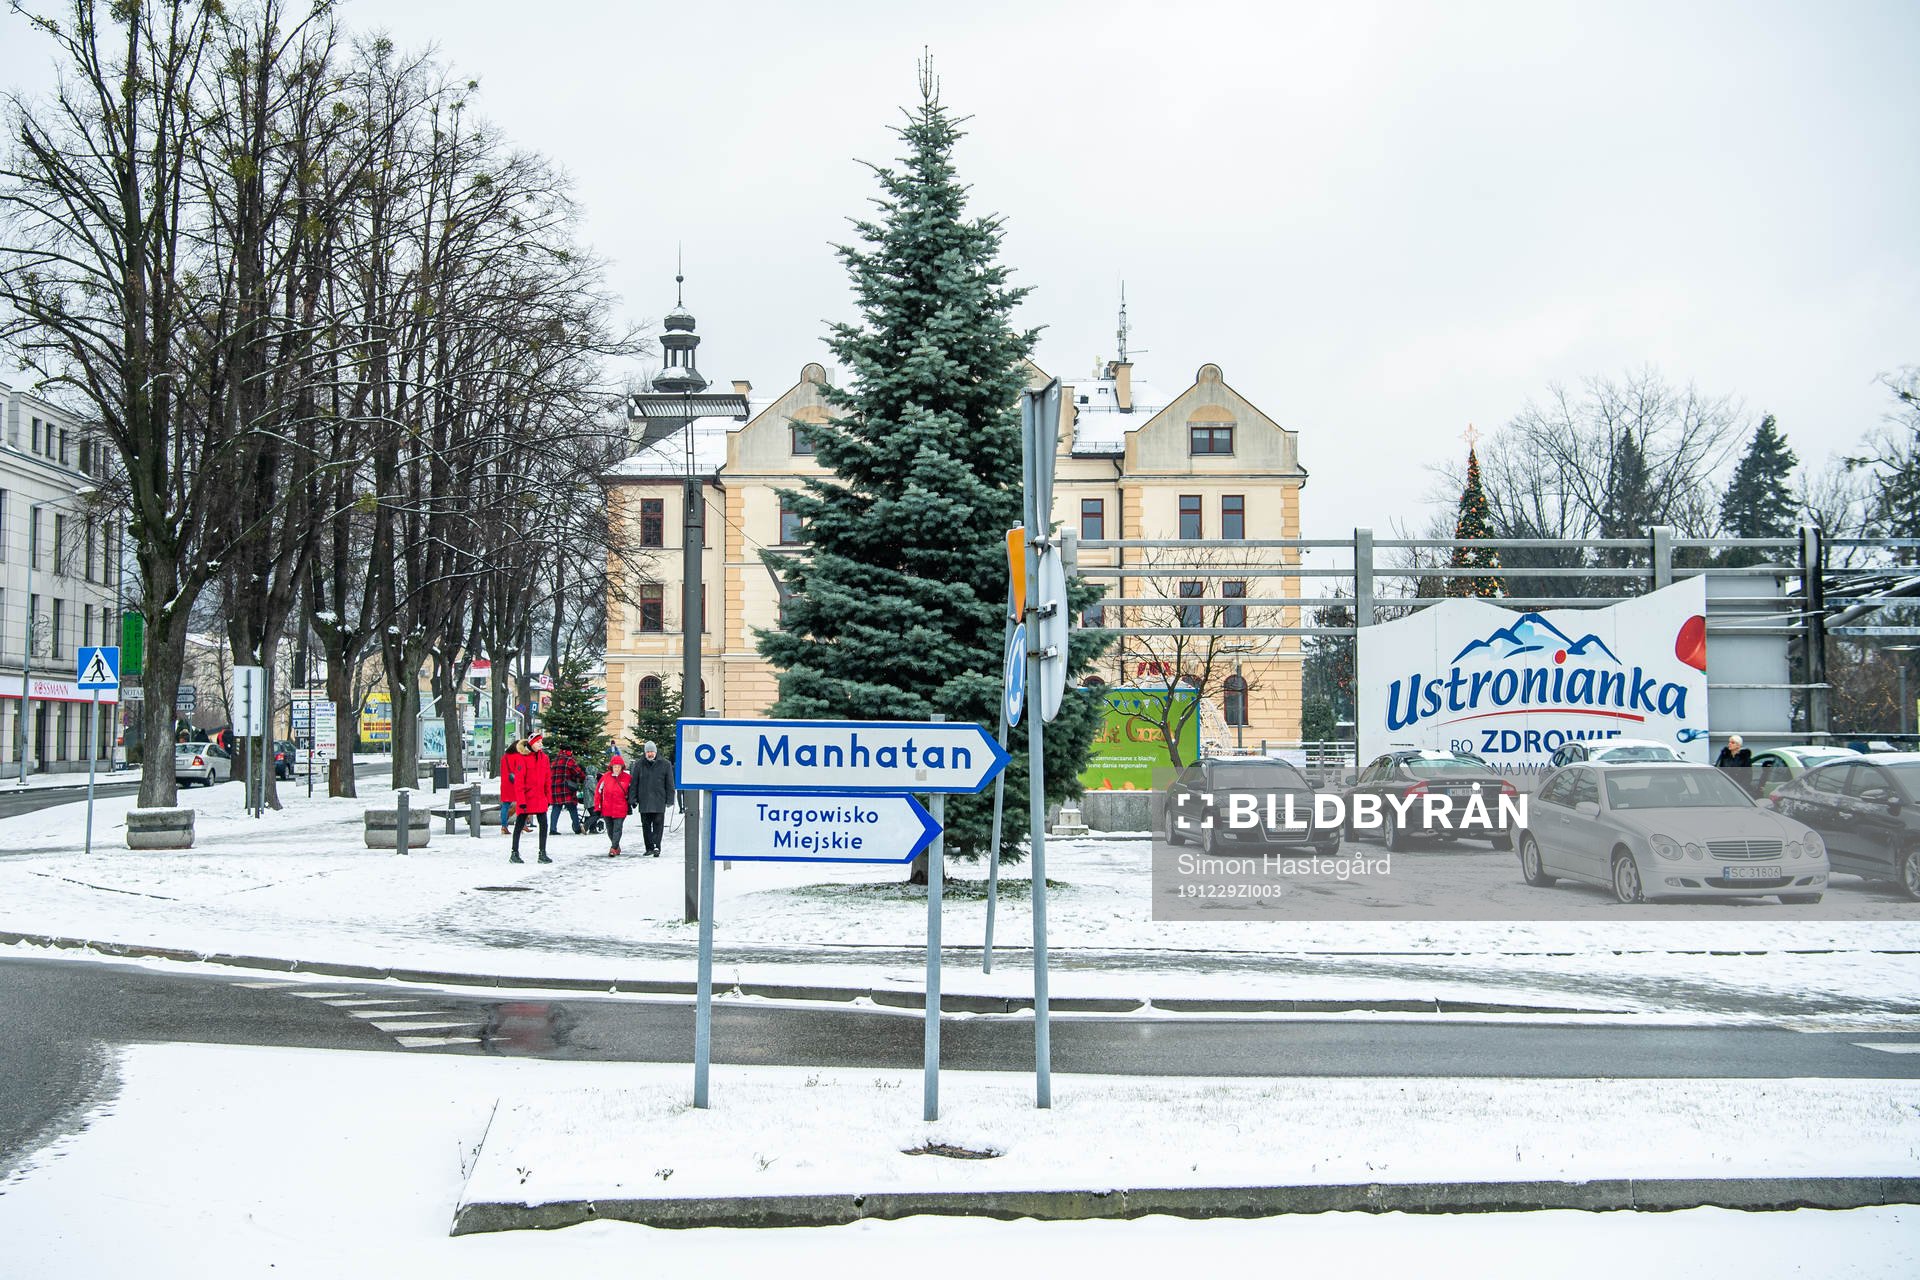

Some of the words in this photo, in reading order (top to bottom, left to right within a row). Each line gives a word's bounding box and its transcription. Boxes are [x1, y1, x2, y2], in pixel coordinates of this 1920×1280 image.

[34, 681, 69, 696] ROSSMANN
[1386, 650, 1688, 731] Ustronianka
[694, 743, 742, 766] os.
[757, 733, 971, 769] Manhatan
[1451, 739, 1473, 753] BO
[756, 803, 879, 827] Targowisko
[774, 831, 863, 853] Miejskie
[1750, 867, 1780, 878] 31806
